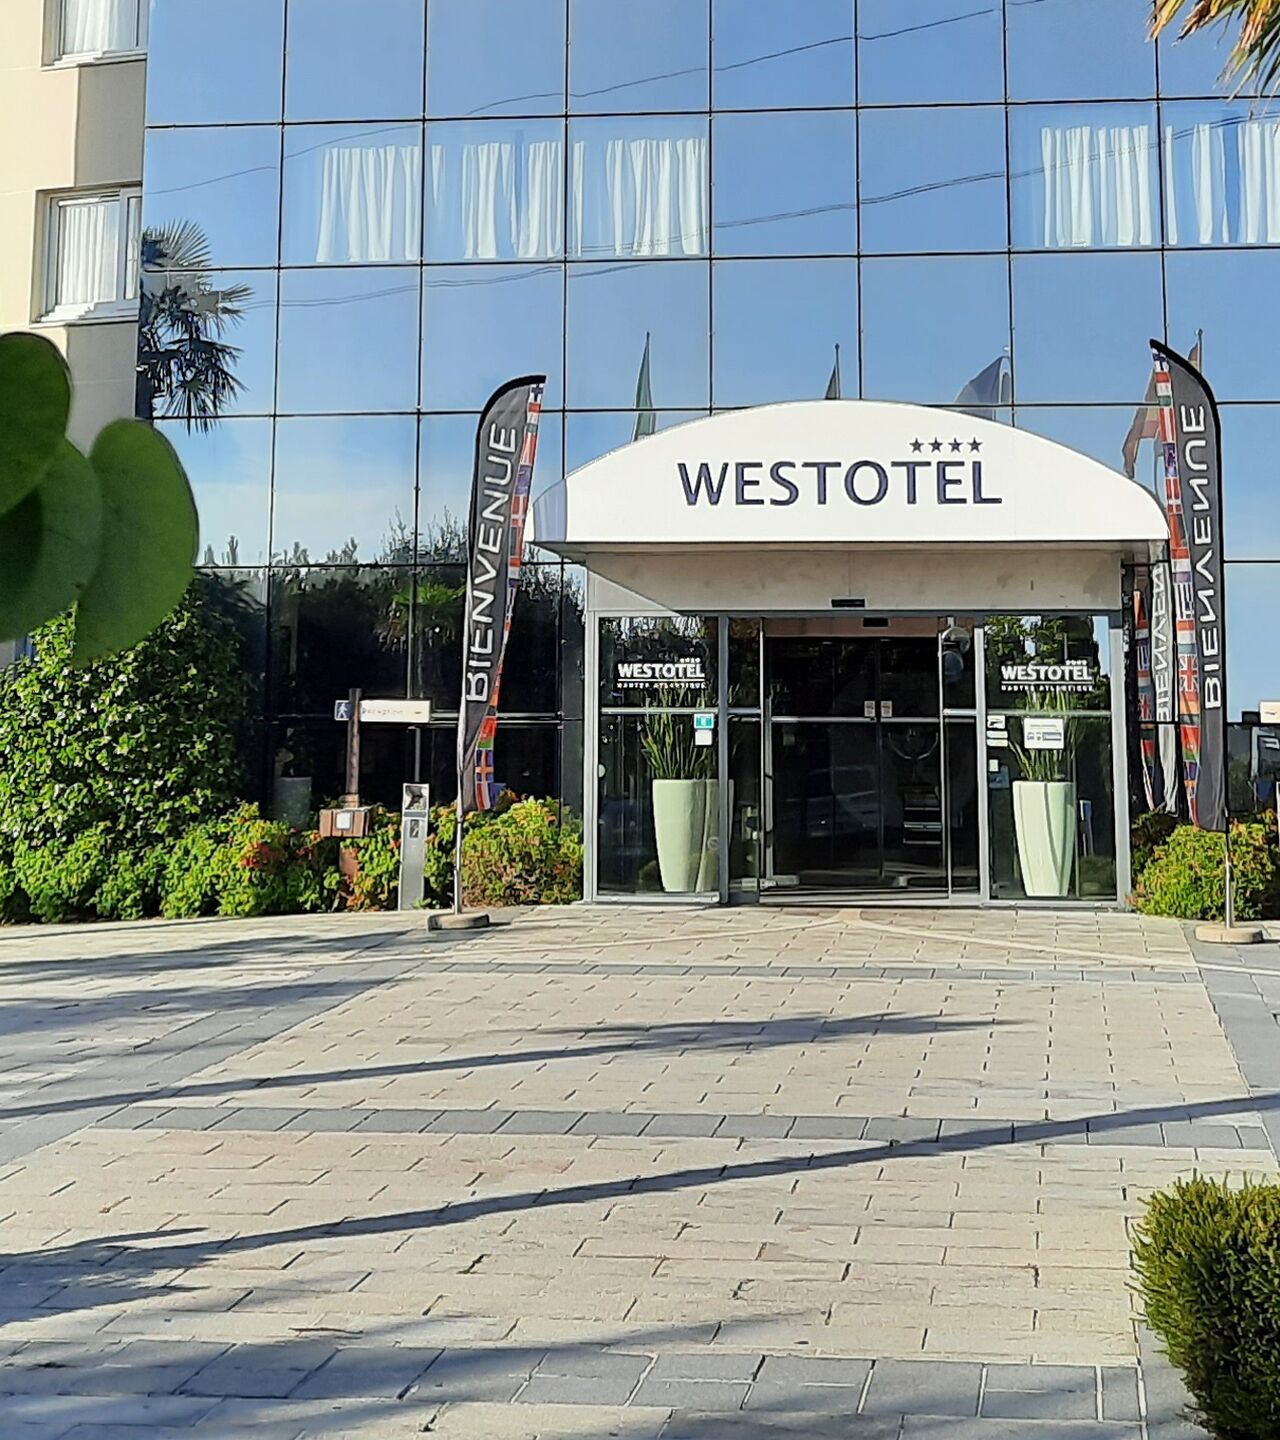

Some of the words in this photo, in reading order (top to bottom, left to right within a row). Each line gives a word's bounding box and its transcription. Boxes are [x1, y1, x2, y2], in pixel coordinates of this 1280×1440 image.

[677, 459, 1003, 506] WESTOTEL
[465, 421, 519, 705] BIENVENUE
[617, 663, 706, 678] WESTOTEL
[1000, 665, 1093, 681] WESTOTEL
